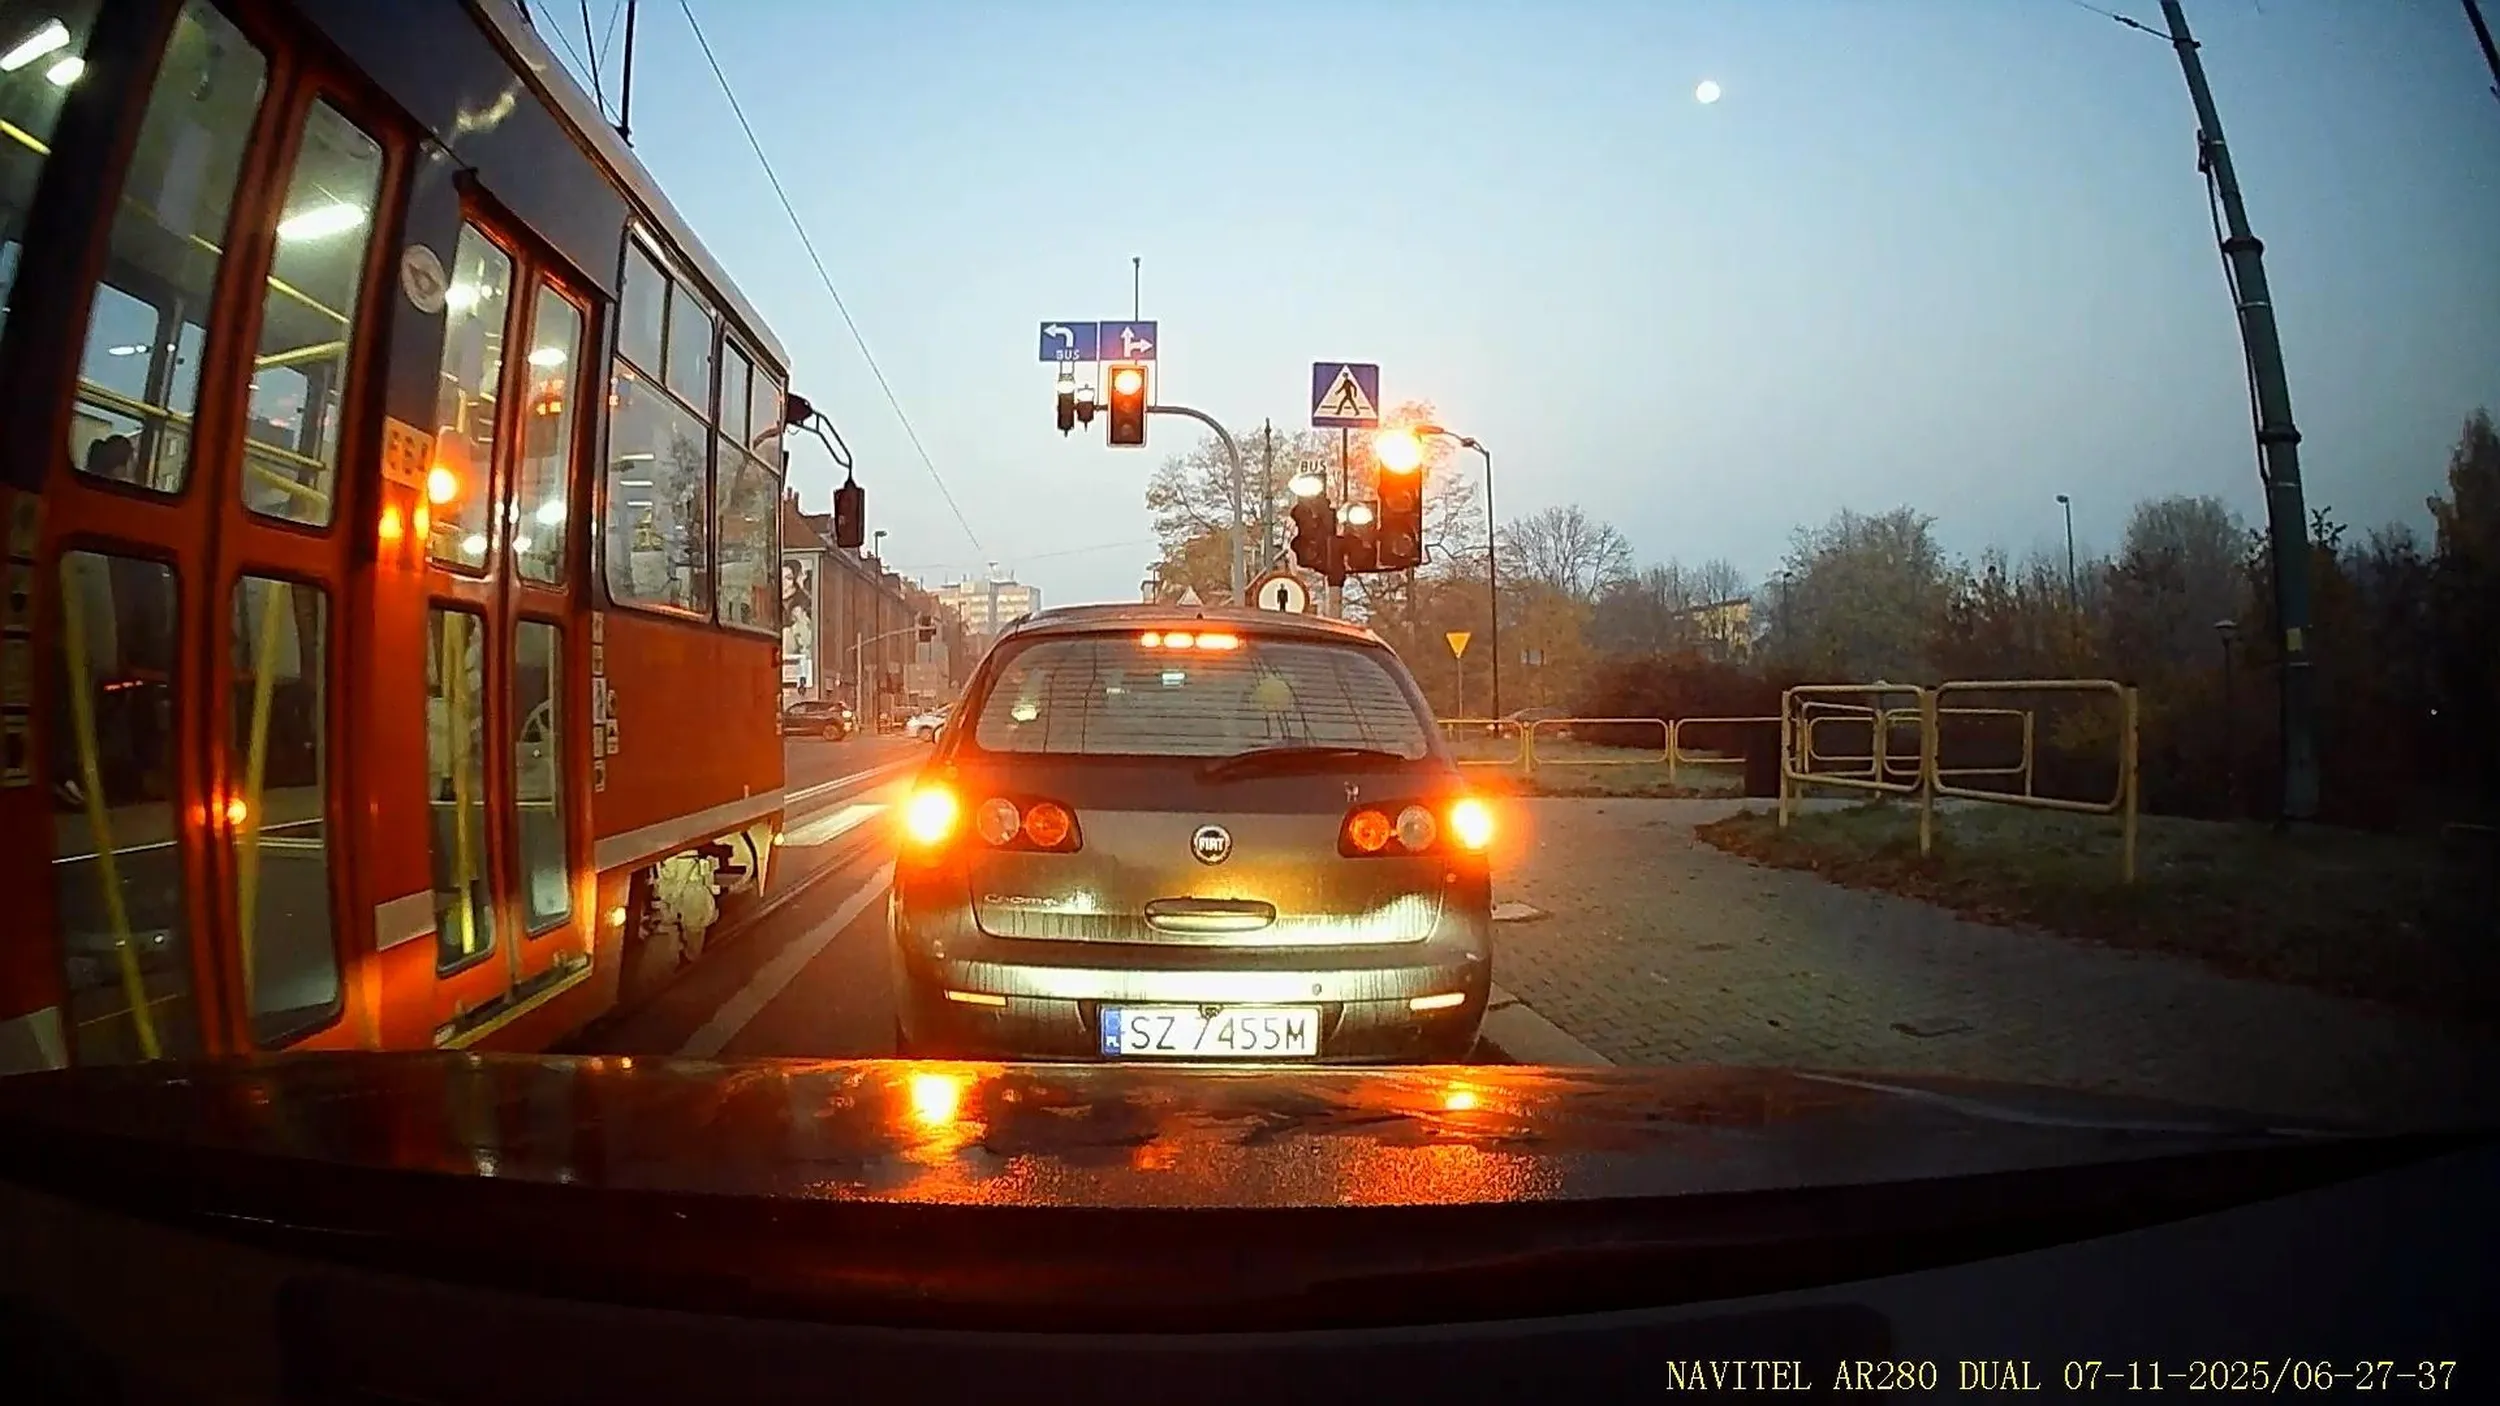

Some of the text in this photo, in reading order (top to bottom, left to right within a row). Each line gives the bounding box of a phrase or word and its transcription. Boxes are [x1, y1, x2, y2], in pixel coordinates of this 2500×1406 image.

[1055, 349, 1080, 360] BUS
[1300, 460, 1326, 473] BUS
[1198, 837, 1225, 851] FIAT
[1131, 1016, 1305, 1050] SZ 7455M
